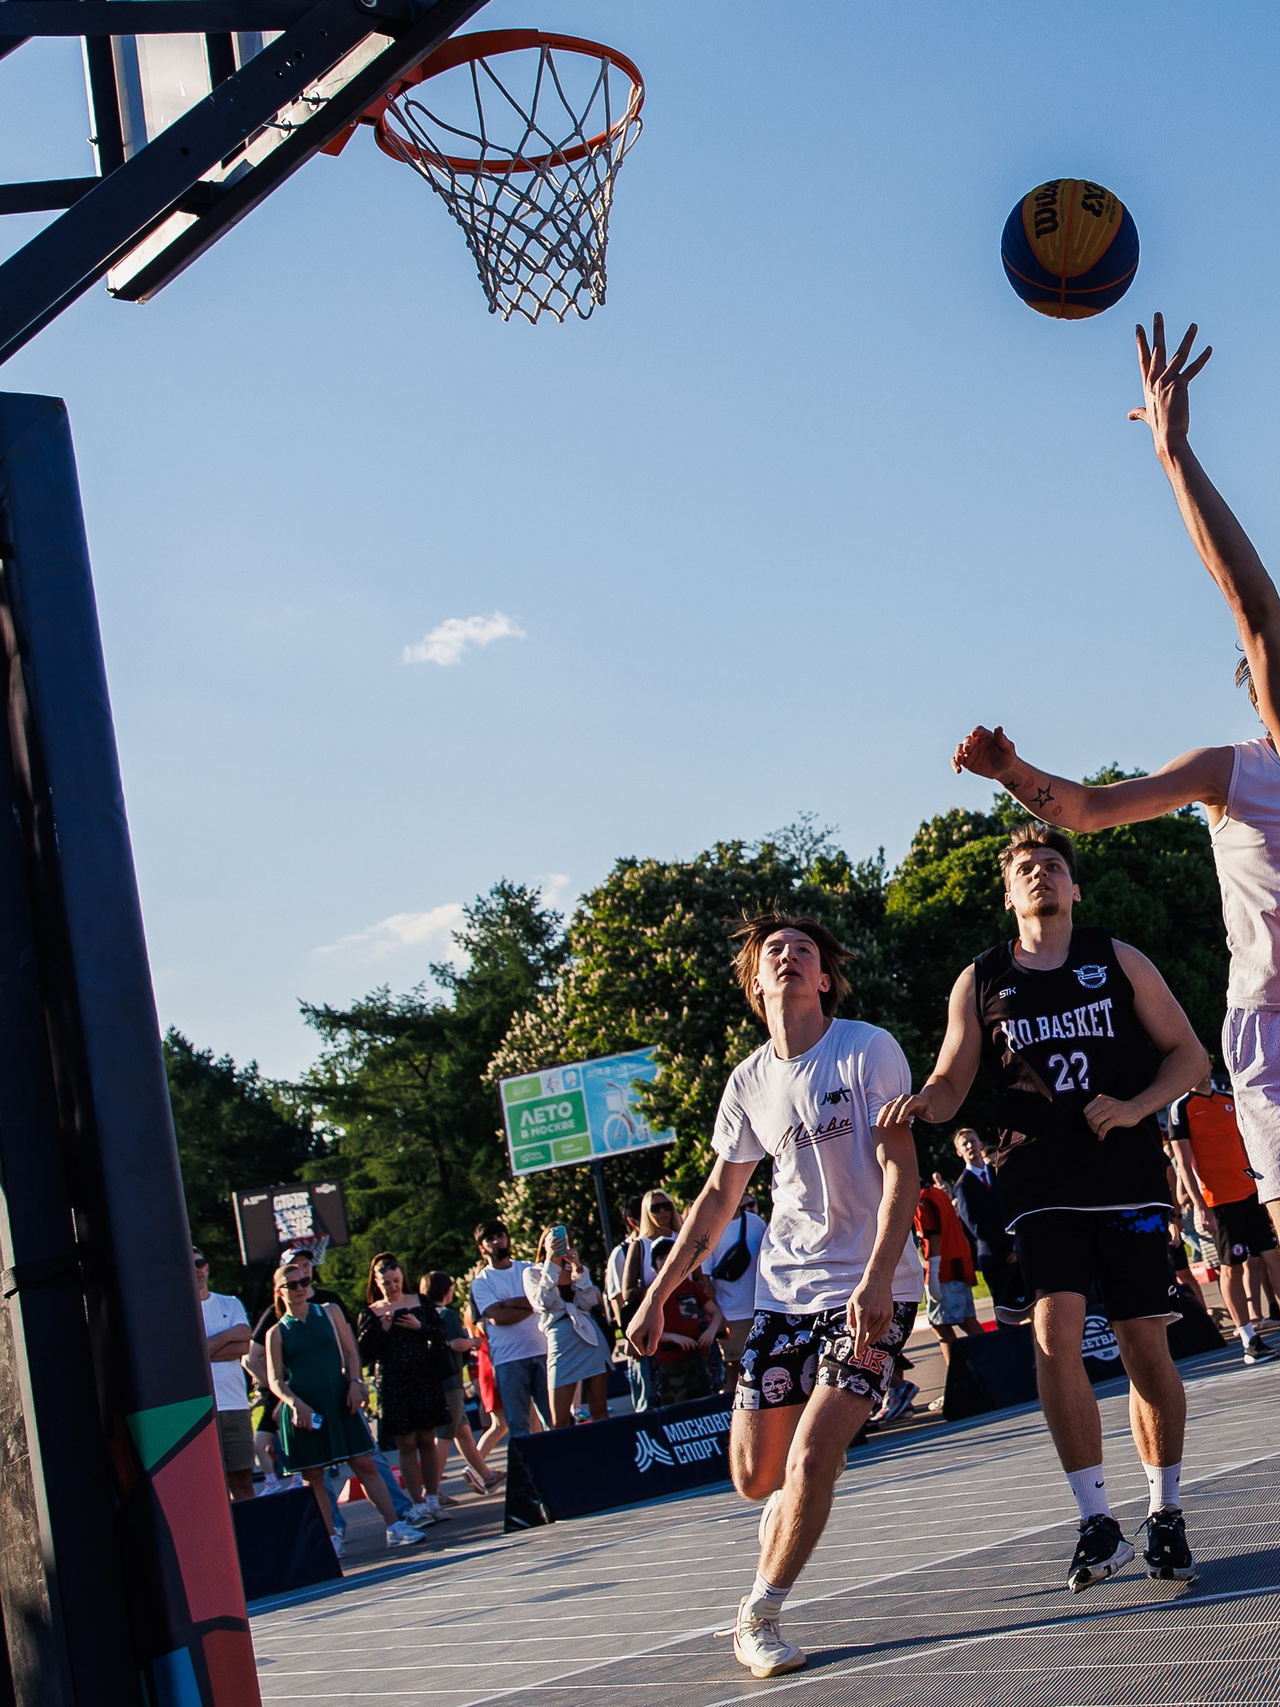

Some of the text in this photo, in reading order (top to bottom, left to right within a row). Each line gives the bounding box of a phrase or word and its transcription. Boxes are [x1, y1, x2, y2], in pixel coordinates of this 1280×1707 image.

[1047, 1051, 1091, 1092] 22
[519, 1101, 574, 1128] ЛЕТО
[520, 1118, 577, 1140] В МОСКВЕ
[662, 1411, 734, 1443] МОСКОВС
[673, 1437, 722, 1464] СПОРТ
